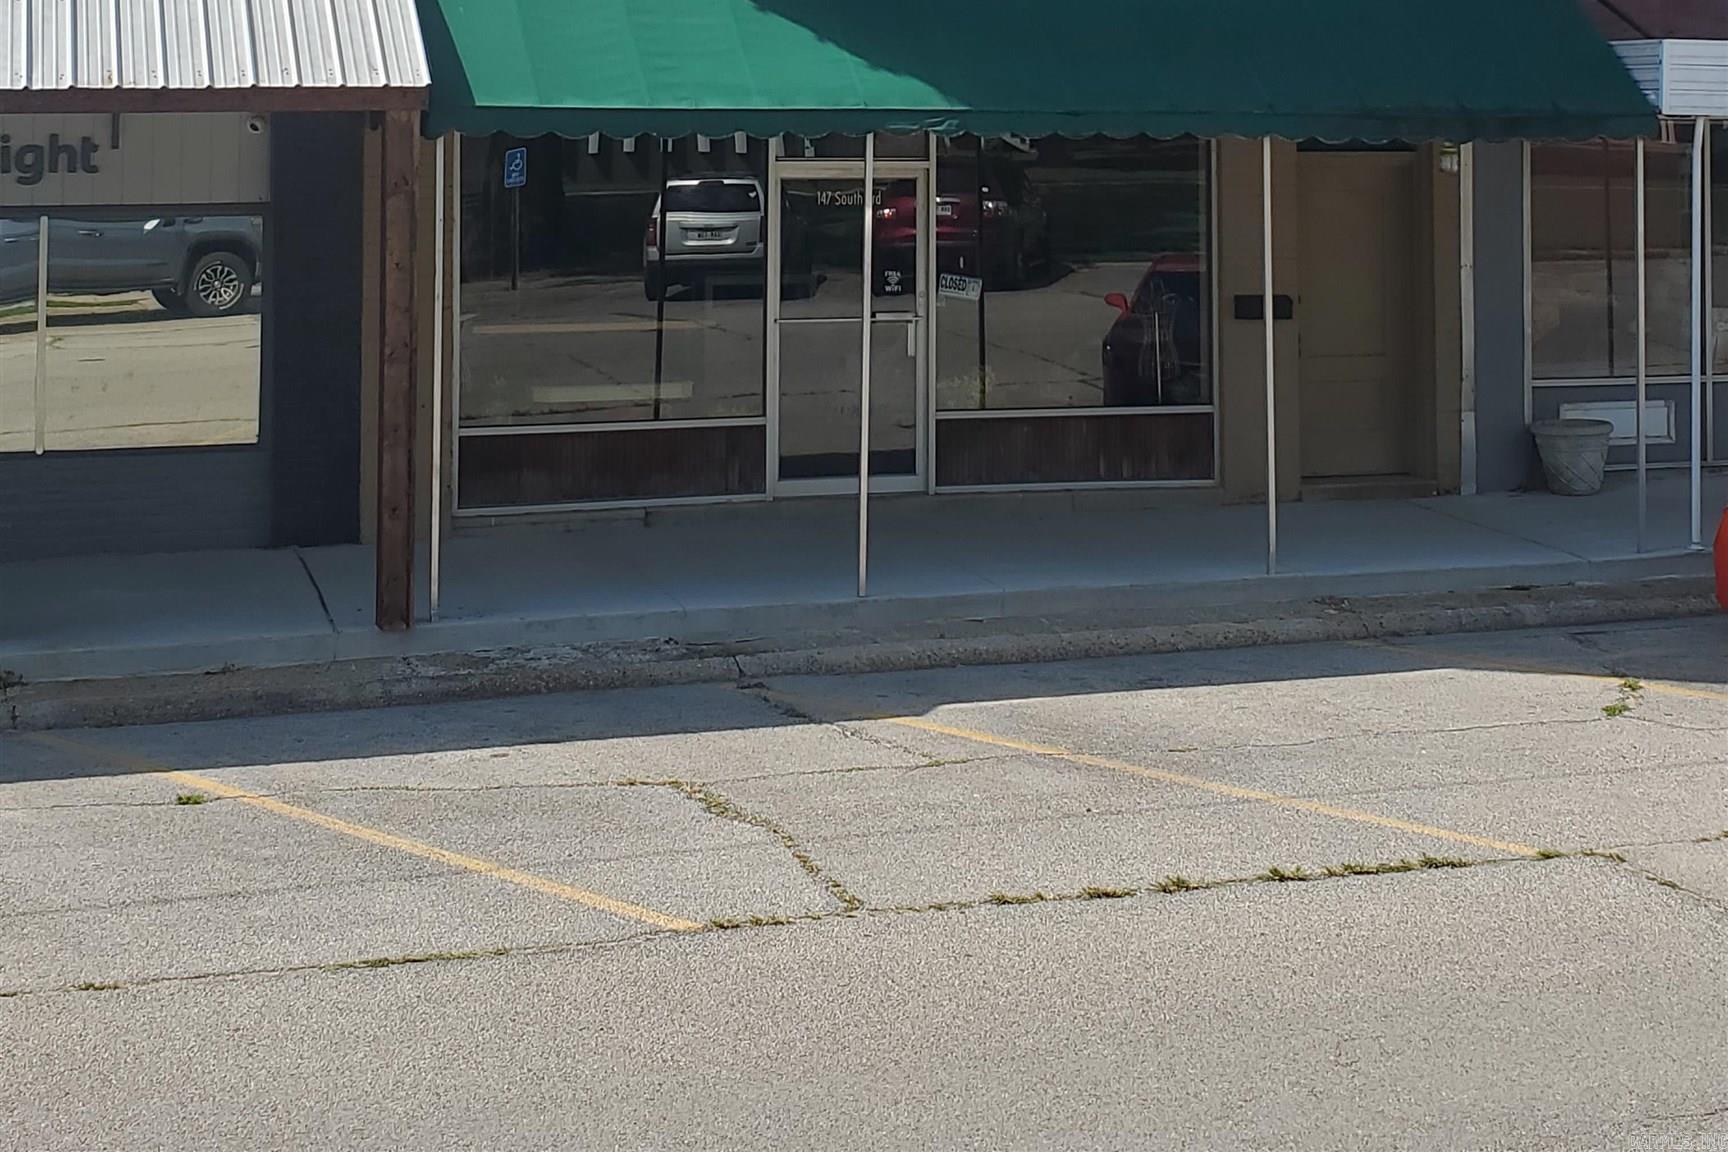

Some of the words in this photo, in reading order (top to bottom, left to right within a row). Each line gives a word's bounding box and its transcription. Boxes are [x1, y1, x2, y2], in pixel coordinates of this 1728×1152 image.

[817, 191, 832, 206] 147
[834, 190, 863, 206] South
[941, 275, 967, 291] CLOSED
